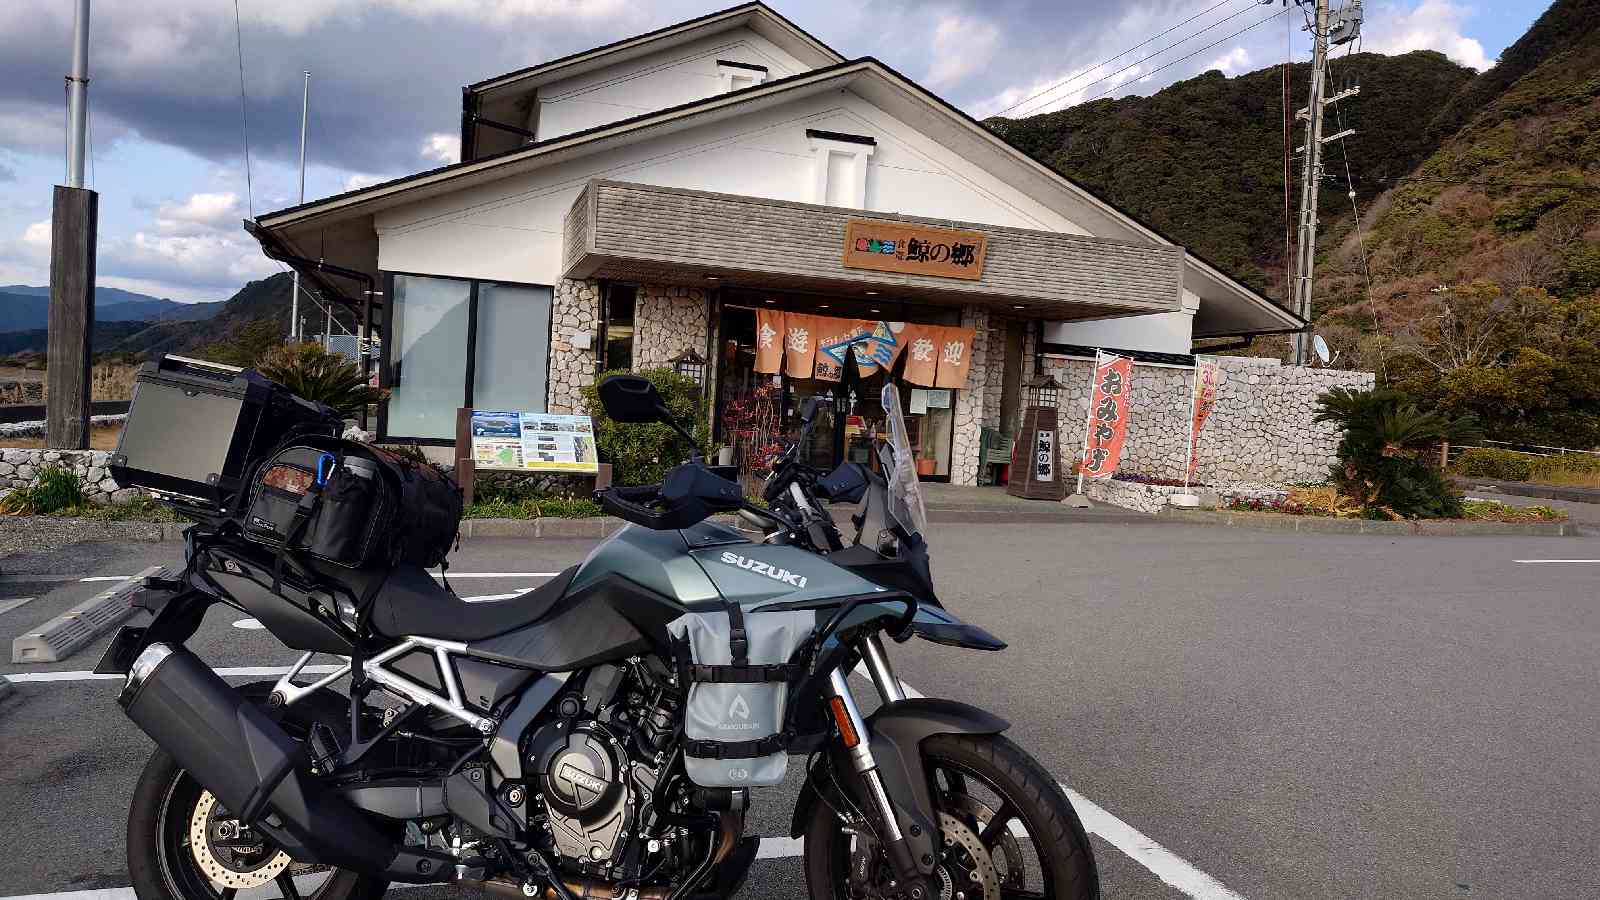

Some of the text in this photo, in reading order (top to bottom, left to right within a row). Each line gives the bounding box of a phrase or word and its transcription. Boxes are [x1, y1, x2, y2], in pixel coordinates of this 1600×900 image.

[906, 237, 976, 267] 鯨の郷
[1086, 367, 1124, 473] おみやげ
[720, 550, 807, 589] SUZUKI
[563, 767, 604, 793] SUZUKI
